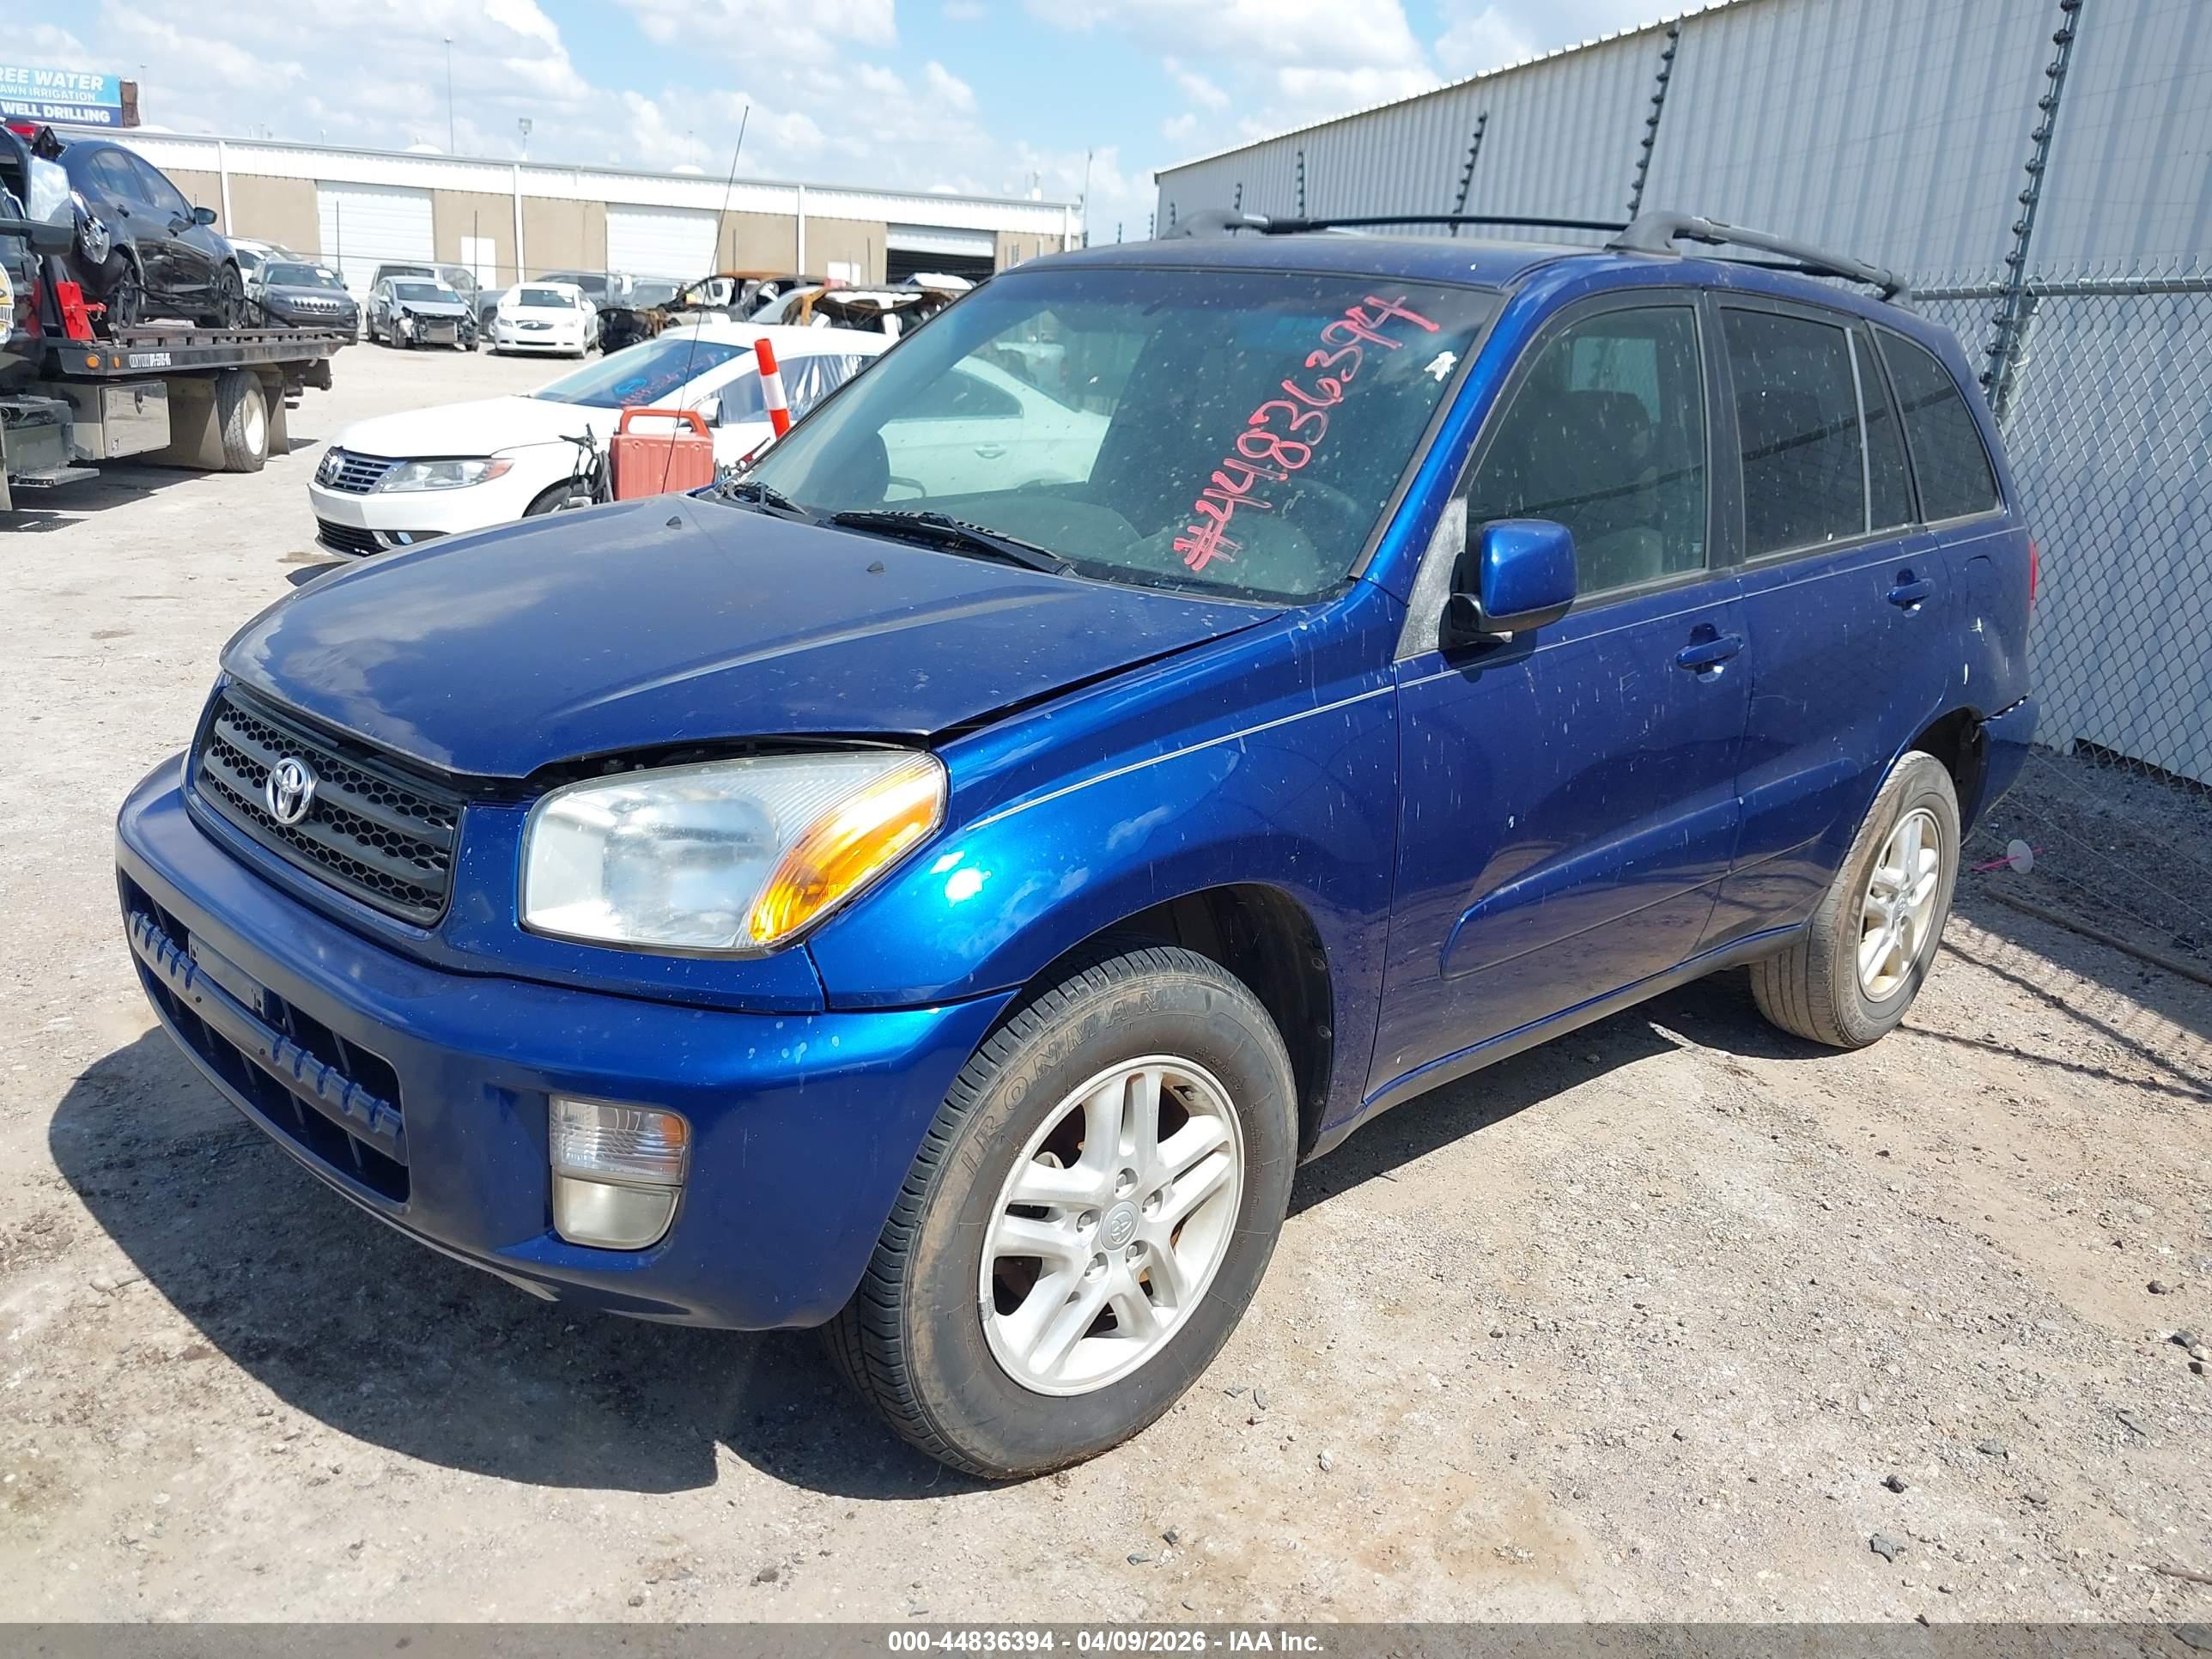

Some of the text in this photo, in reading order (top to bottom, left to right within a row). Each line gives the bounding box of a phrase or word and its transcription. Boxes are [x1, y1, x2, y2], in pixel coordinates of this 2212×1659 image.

[34, 70, 104, 91] WATER
[29, 87, 96, 102] IRRIGATION
[1, 100, 111, 123] WELL DRILLING
[1173, 295, 1440, 571] #44836394
[961, 990, 1161, 1175] IRONMAN
